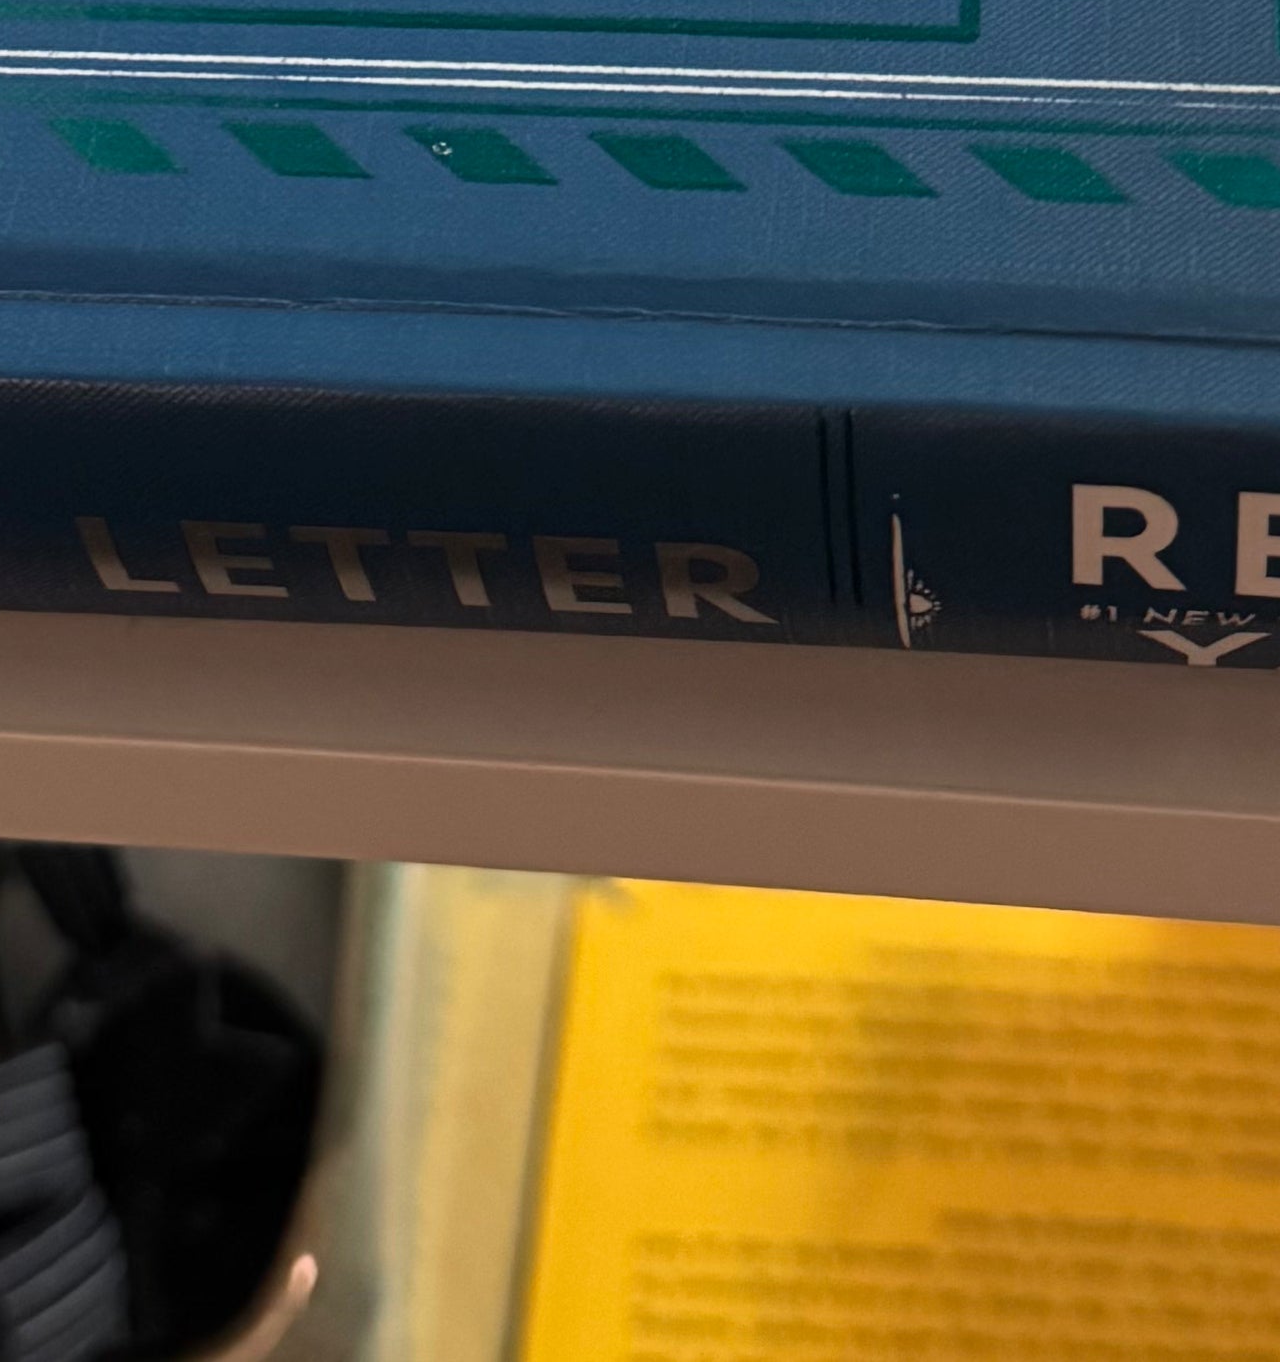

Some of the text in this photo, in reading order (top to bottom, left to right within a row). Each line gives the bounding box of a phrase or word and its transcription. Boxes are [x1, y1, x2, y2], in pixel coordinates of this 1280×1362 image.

[77, 515, 782, 627] LETTER
[1079, 604, 1119, 624] #1
[1141, 606, 1256, 629] NEW
